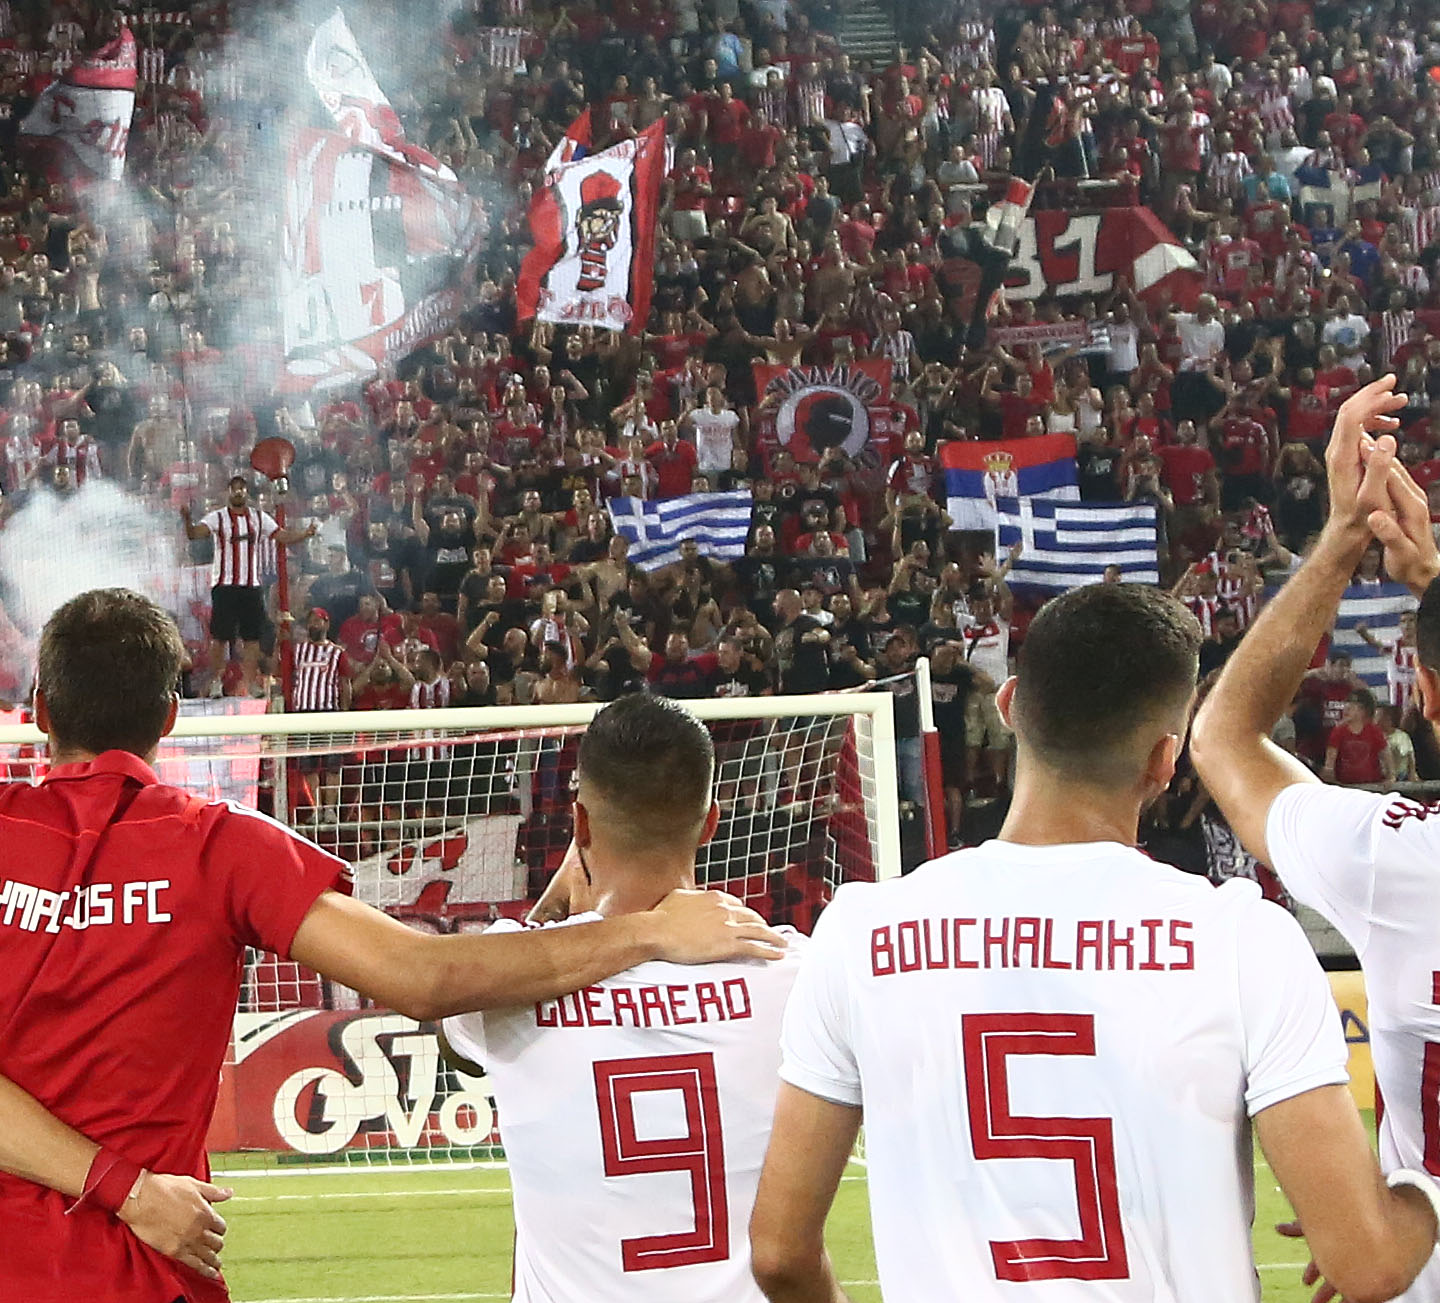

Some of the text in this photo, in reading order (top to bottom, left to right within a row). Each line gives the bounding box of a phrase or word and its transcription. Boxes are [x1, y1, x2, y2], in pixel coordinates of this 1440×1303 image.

[123, 879, 173, 925] FC
[870, 915, 1197, 978] BOUCHALAKIS
[534, 976, 752, 1030] GUERRERO
[592, 1051, 730, 1274] 9
[960, 1012, 1131, 1283] 5
